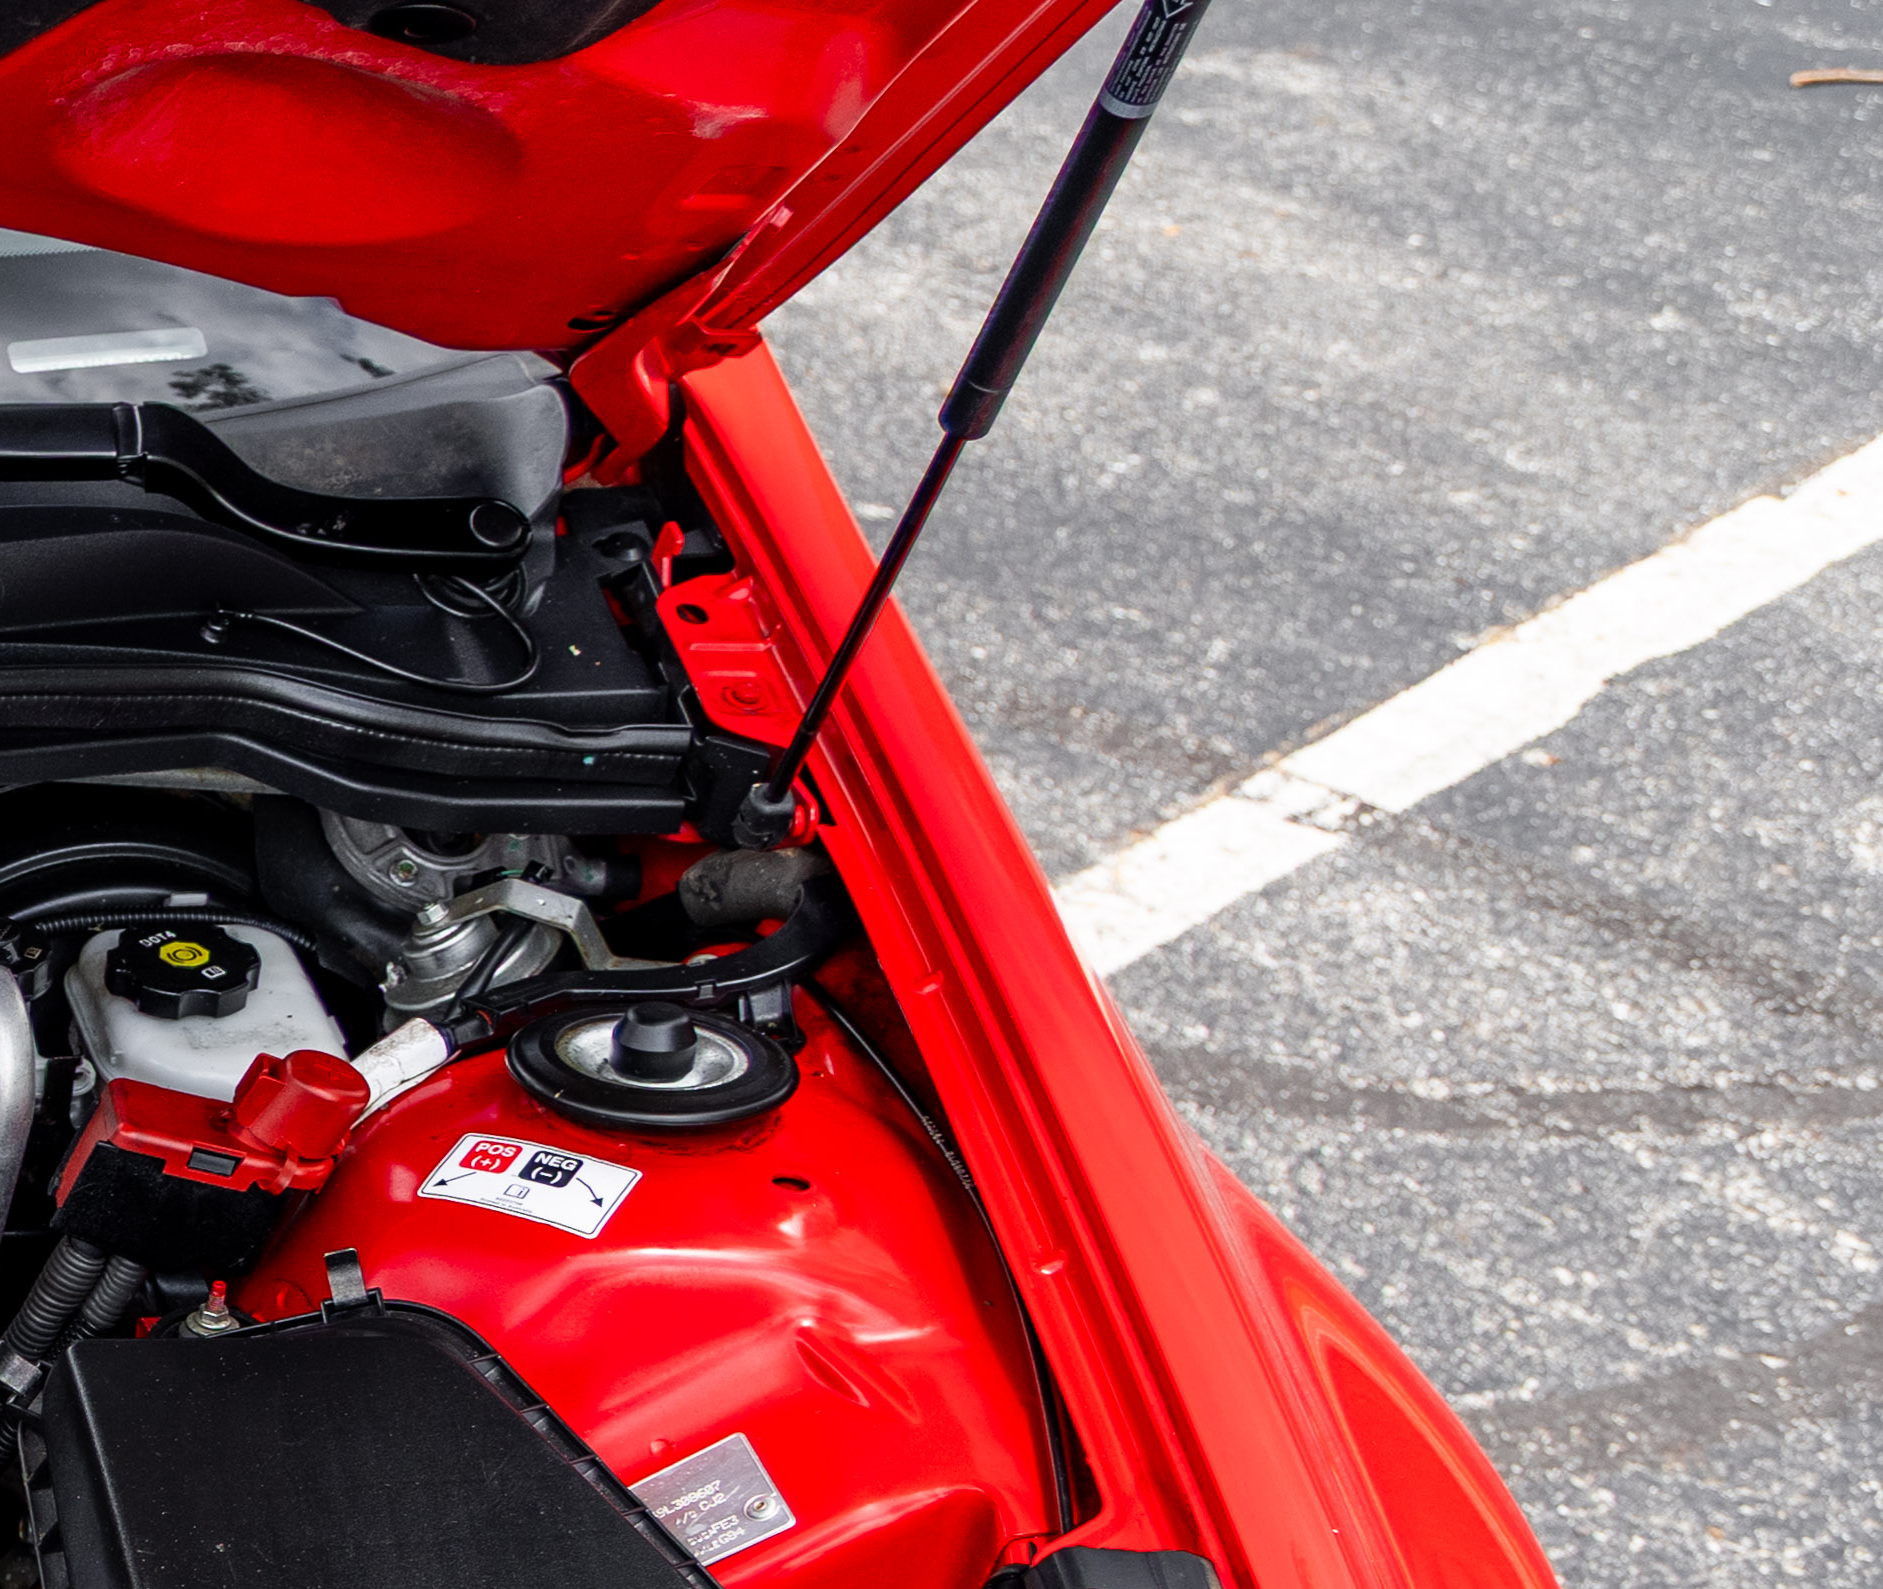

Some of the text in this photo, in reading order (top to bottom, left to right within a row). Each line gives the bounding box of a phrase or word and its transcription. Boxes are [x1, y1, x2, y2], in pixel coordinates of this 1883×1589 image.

[138, 930, 176, 947] DOT4
[475, 1142, 517, 1158] POS
[534, 1152, 578, 1172] NEG
